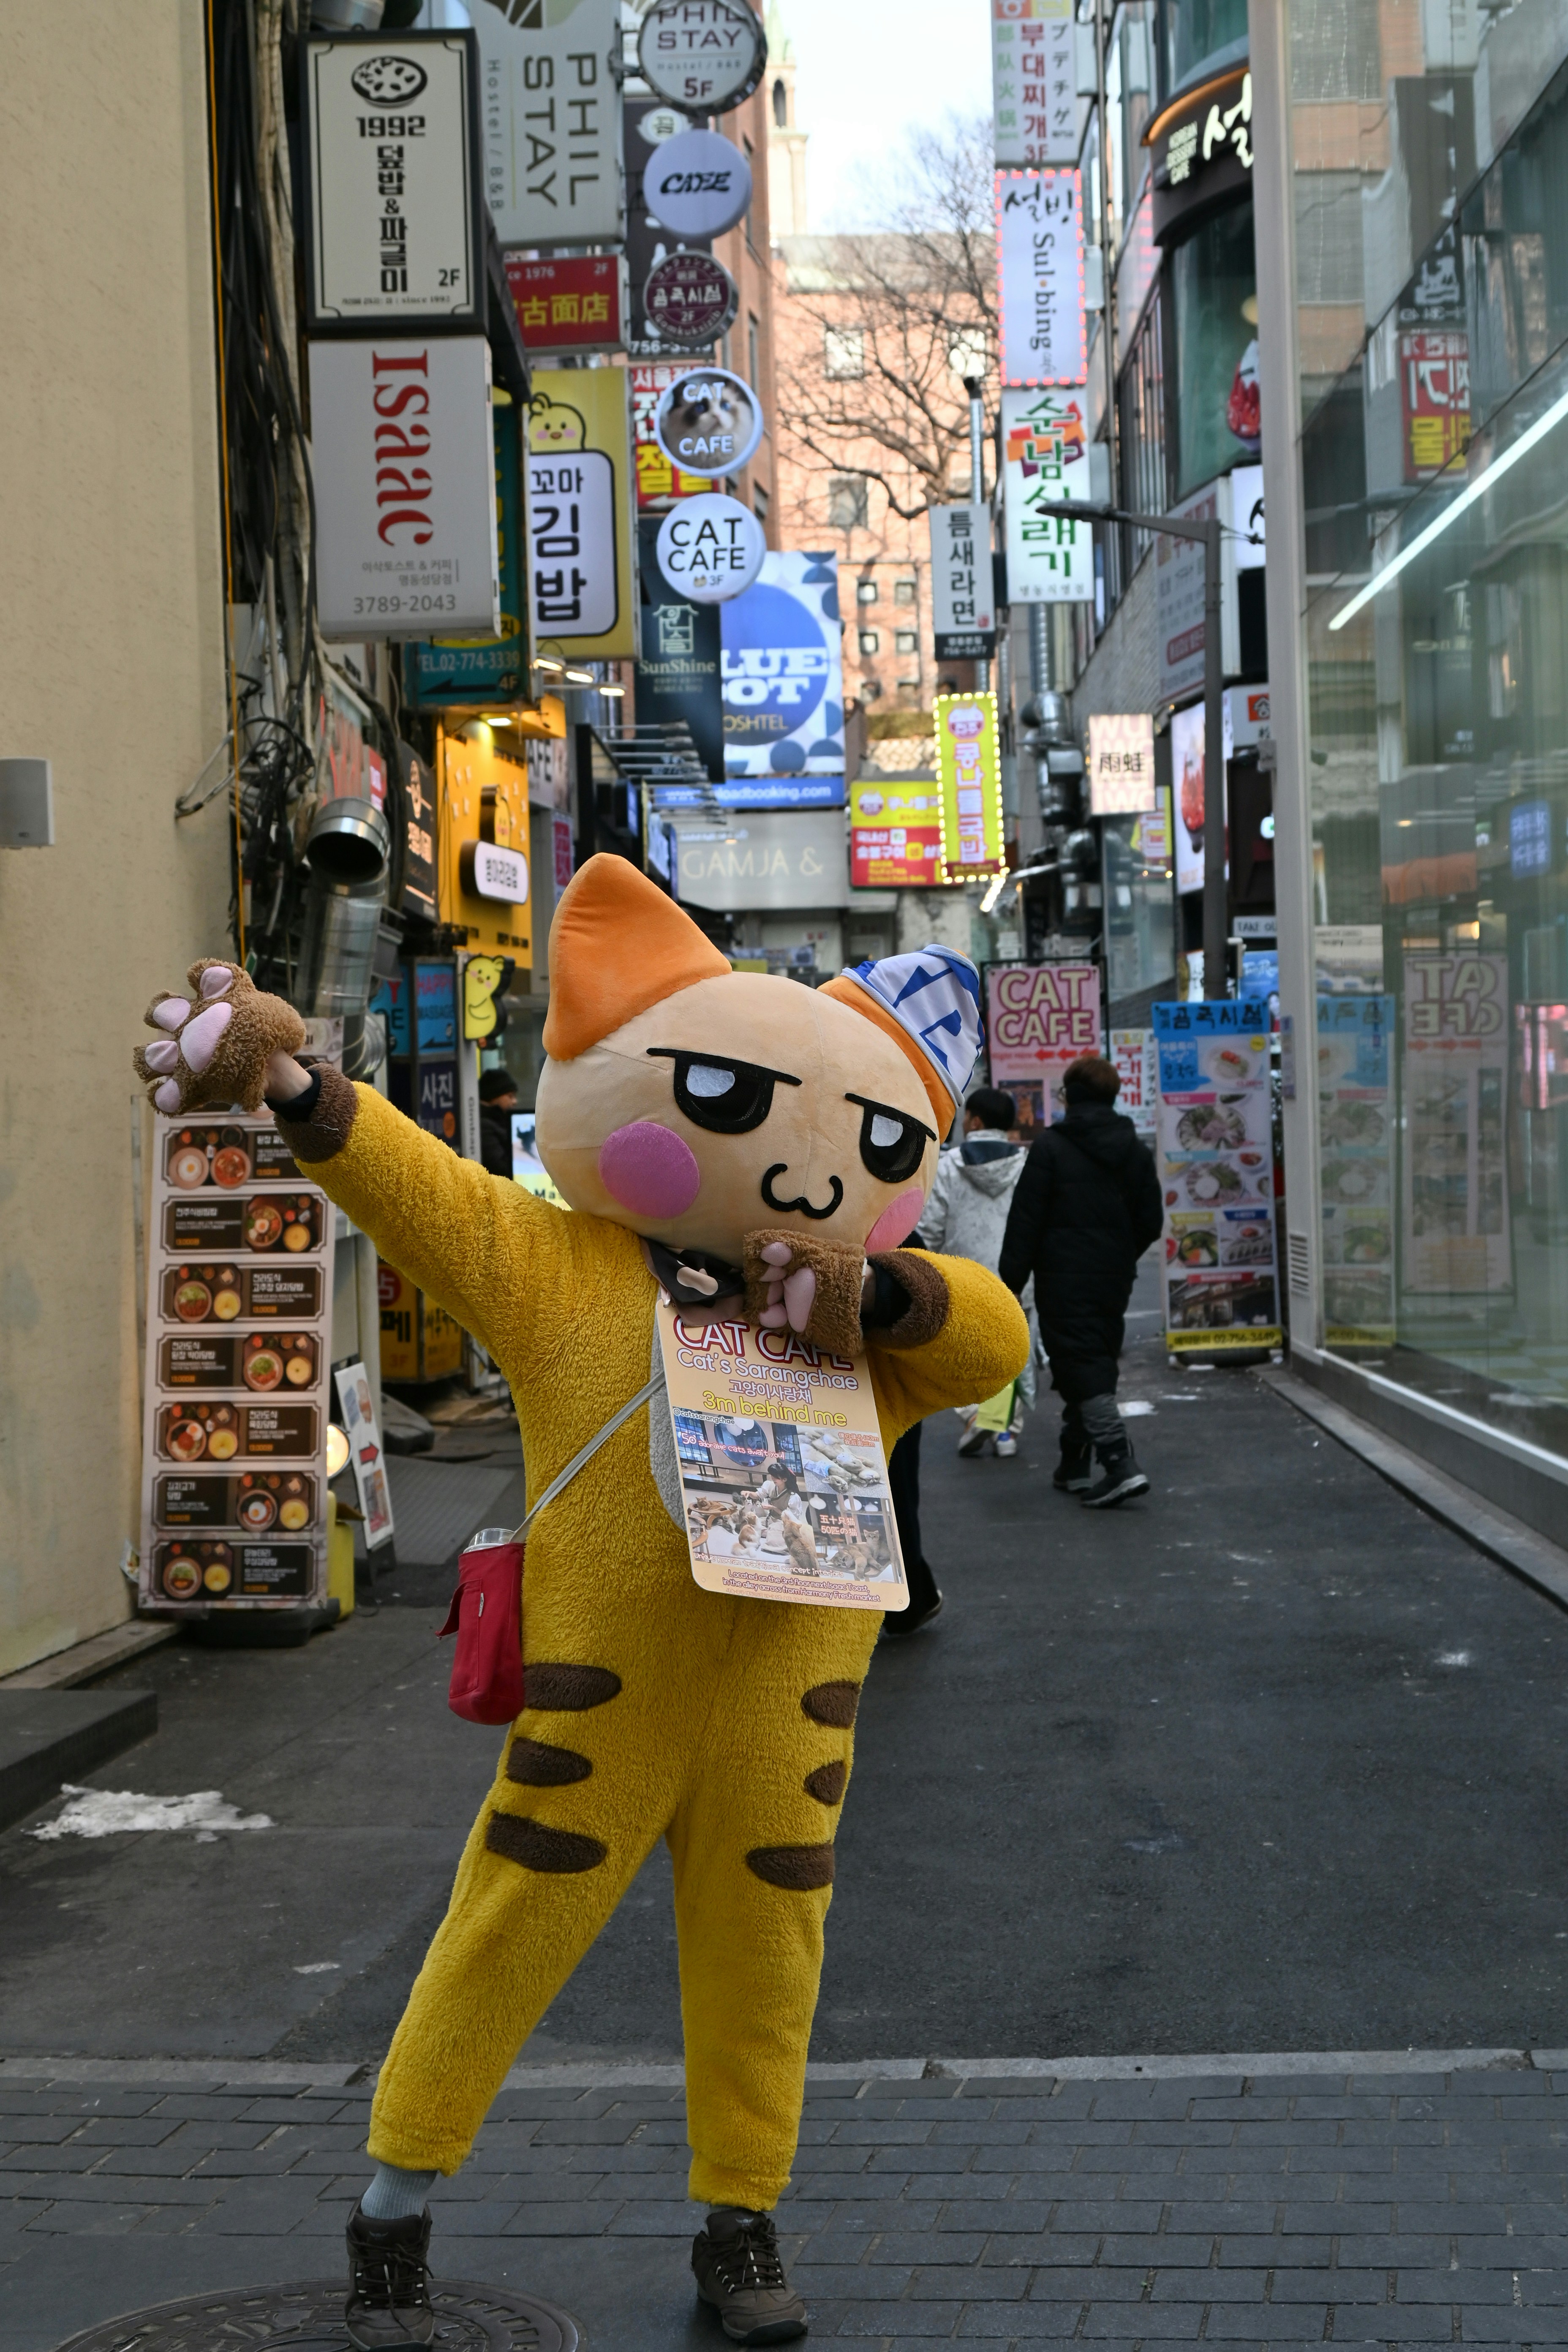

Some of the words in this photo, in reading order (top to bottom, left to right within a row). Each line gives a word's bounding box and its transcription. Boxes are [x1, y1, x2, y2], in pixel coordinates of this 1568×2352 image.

[658, 29, 741, 49] STAY
[684, 76, 713, 98] 5F
[1021, 24, 1046, 139] 부대찌개
[487, 59, 502, 140] Hostel
[357, 115, 426, 138] 1992
[523, 55, 557, 208] STAY
[566, 52, 599, 206] PHIL
[490, 166, 504, 210] B&B
[660, 171, 731, 194] CAFE
[438, 269, 460, 286] 2F
[525, 266, 555, 280] 1976
[594, 262, 608, 275] 2F
[513, 291, 610, 328] 古面店
[681, 310, 694, 322] 2F
[682, 381, 725, 402] CAT
[372, 349, 434, 547] Isaac
[678, 435, 733, 457] CAFE
[531, 468, 584, 495] 꼬마
[1015, 396, 1078, 577] 순남시래기
[670, 517, 743, 547] CAT
[362, 560, 416, 572] 이삭토스트
[418, 560, 427, 570] &
[430, 558, 452, 571] 커피
[533, 504, 587, 622] 김밥
[667, 547, 746, 573] CAFE
[948, 510, 977, 625] 틈새라면
[709, 574, 724, 586] 3F
[353, 594, 456, 614] 3789-2043
[640, 658, 716, 675] SunShine
[721, 647, 828, 678] LUE
[722, 677, 809, 706] OT
[723, 714, 788, 732] OSHTEL
[682, 848, 789, 879] GAMJA
[800, 847, 823, 877] &
[997, 969, 1093, 1011] CAT
[996, 1012, 1094, 1048] CAFE
[422, 1071, 453, 1109] 사진
[673, 1314, 750, 1357] CAT
[677, 1348, 731, 1374] Cat's
[735, 1358, 859, 1391] Sarangchae
[729, 1380, 813, 1405] 고양이사랑채
[673, 1407, 735, 1425] @catssarangchae
[703, 1390, 736, 1414] 3m
[739, 1396, 810, 1424] behind
[814, 1409, 847, 1427] me
[681, 1432, 697, 1445] 50
[698, 1440, 727, 1451] adorable
[727, 1446, 746, 1454] cats
[747, 1448, 768, 1457] await
[769, 1451, 785, 1460] you!
[819, 1514, 856, 1526] 五十只猫
[820, 1525, 858, 1537] 50匹の猫
[693, 1552, 716, 1562] Unique
[743, 1560, 780, 1571] traditional
[781, 1566, 811, 1576] concept
[811, 1568, 844, 1578] interiors
[722, 1577, 730, 1586] in
[730, 1579, 743, 1587] the
[743, 1581, 759, 1591] alley
[759, 1584, 782, 1593] across
[782, 1586, 801, 1595] from
[800, 1588, 833, 1600] Harmony
[833, 1591, 855, 1600] Fresh
[855, 1593, 881, 1602] market
[728, 1569, 758, 1581] Located
[768, 1574, 781, 1584] the
[781, 1576, 793, 1585] 3rd
[794, 1578, 810, 1587] floor
[811, 1582, 828, 1590] next
[828, 1582, 847, 1591] Isaac
[847, 1584, 870, 1593] Toast,
